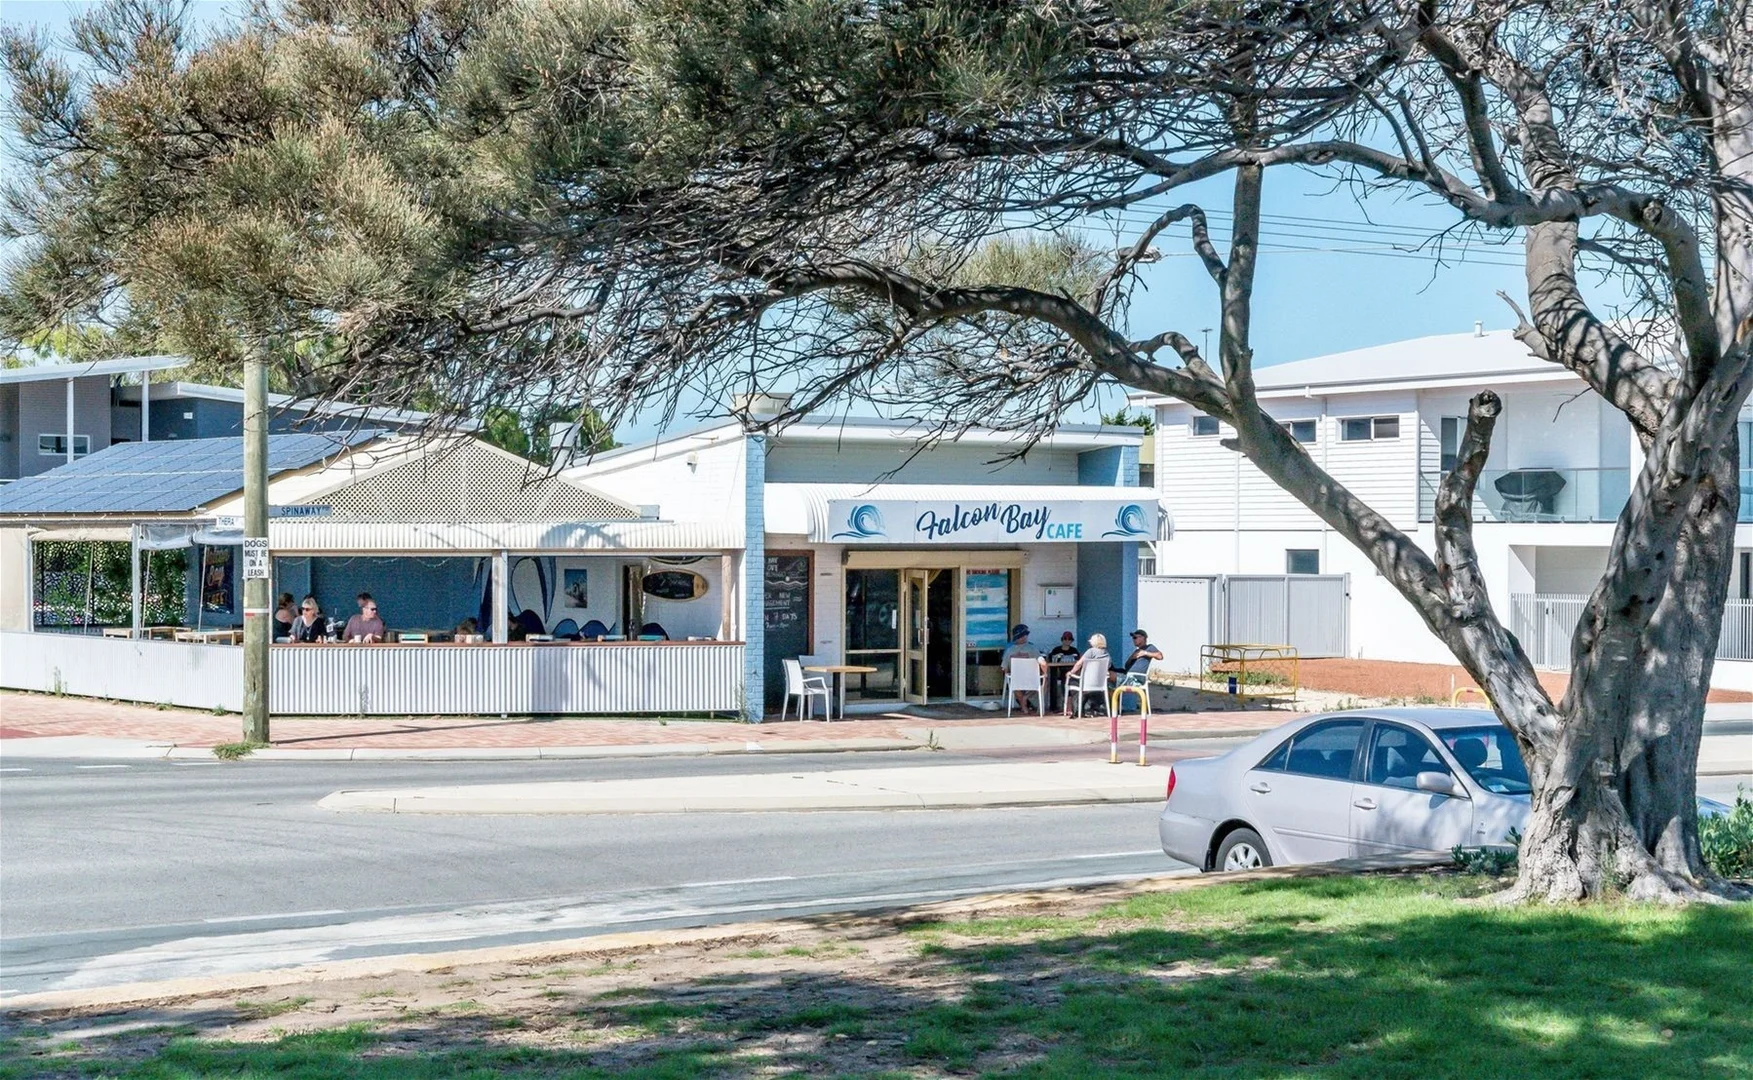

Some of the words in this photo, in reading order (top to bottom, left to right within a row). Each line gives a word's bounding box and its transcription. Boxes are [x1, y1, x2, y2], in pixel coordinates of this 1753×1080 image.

[281, 506, 321, 516] SPINAWAY
[218, 517, 235, 526] THERA
[916, 502, 1001, 540] Falcon
[1000, 504, 1051, 540] Bay
[1046, 523, 1083, 539] CAFE
[244, 540, 268, 548] DOGS
[244, 549, 258, 557] MUST
[260, 549, 267, 557] BE
[247, 569, 264, 577] LEASH
